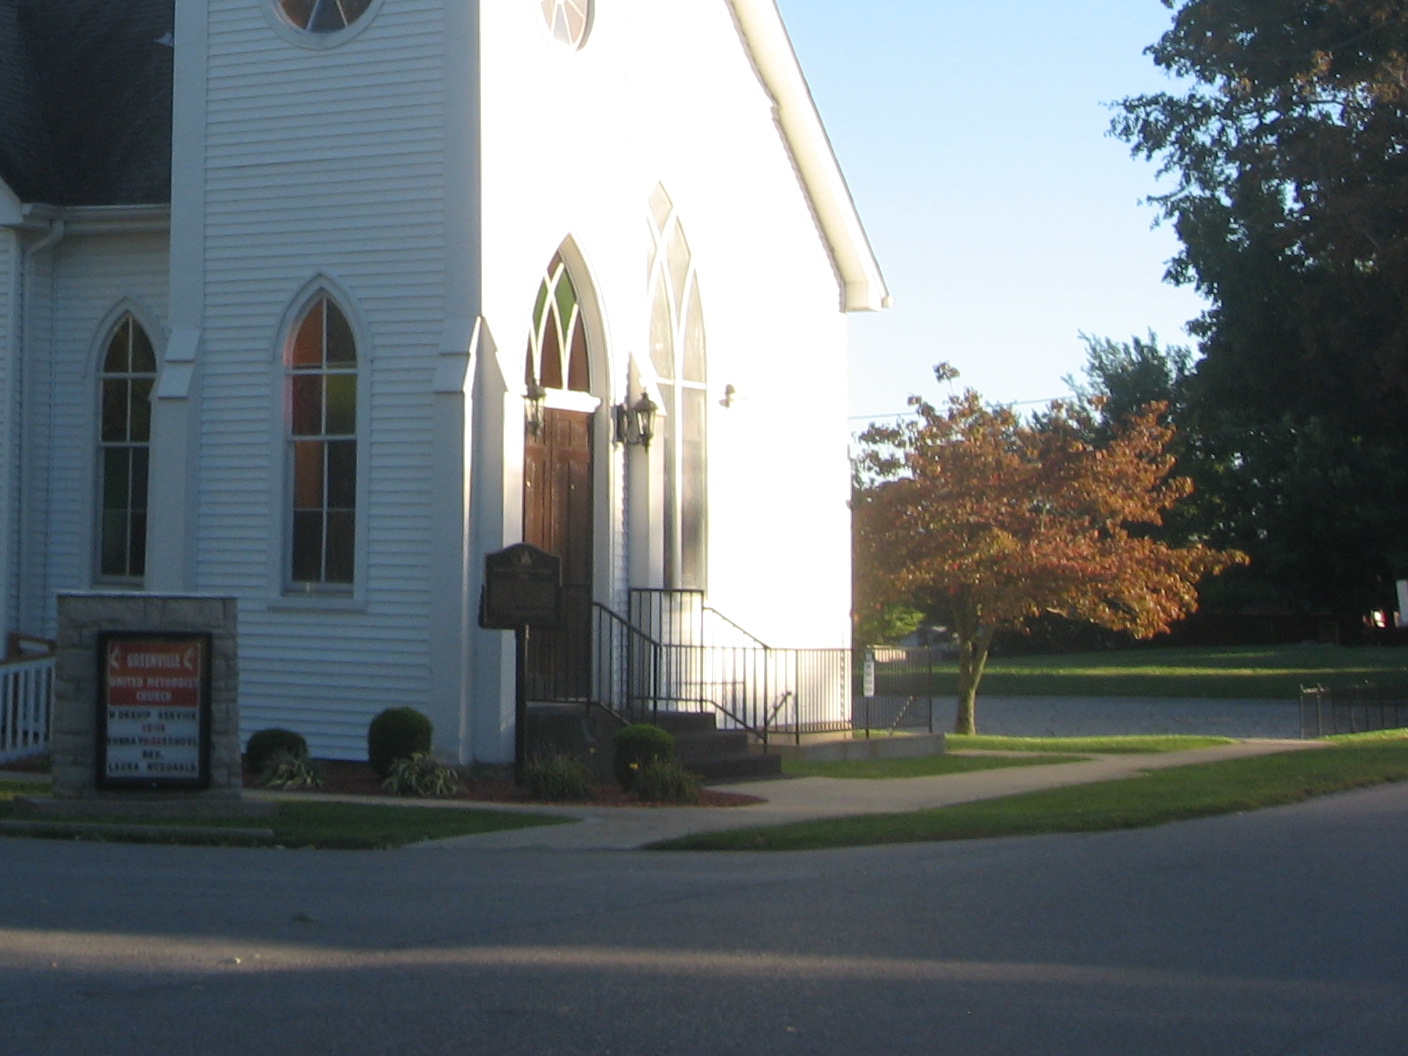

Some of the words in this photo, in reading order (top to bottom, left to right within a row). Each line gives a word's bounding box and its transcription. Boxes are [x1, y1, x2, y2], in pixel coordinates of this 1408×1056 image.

[127, 653, 180, 668] GREENVILLE
[109, 677, 143, 687] UNITED
[147, 677, 199, 688] METHODIST
[136, 691, 172, 702] CHURCH
[109, 710, 151, 719] WORSHIP
[158, 711, 197, 720] SERVICE
